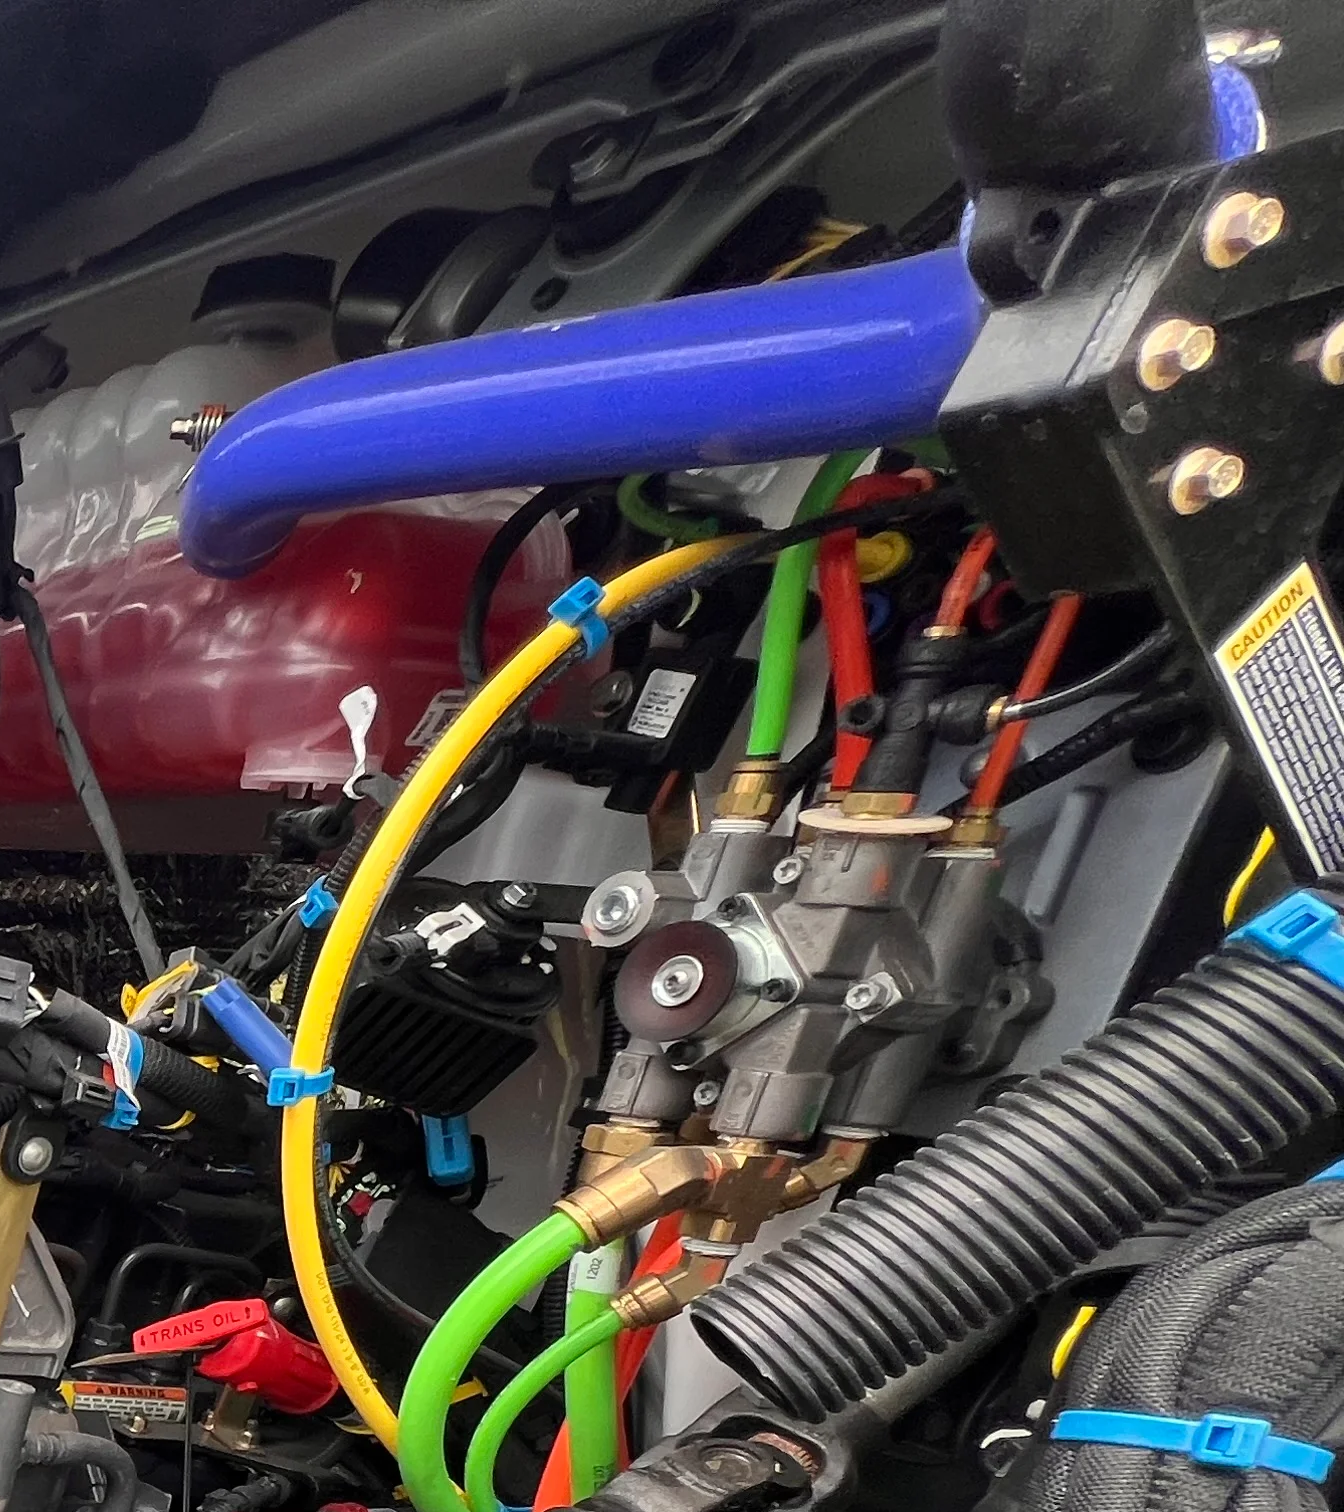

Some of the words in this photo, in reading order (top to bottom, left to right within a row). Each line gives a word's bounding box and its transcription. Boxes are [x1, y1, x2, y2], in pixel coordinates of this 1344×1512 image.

[1230, 581, 1305, 660] CAUTION
[1298, 600, 1335, 663] Extended
[1323, 657, 1342, 688] Life
[149, 1319, 205, 1344] TRANS
[212, 1311, 241, 1328] OIL
[110, 1386, 166, 1399] WARNING
